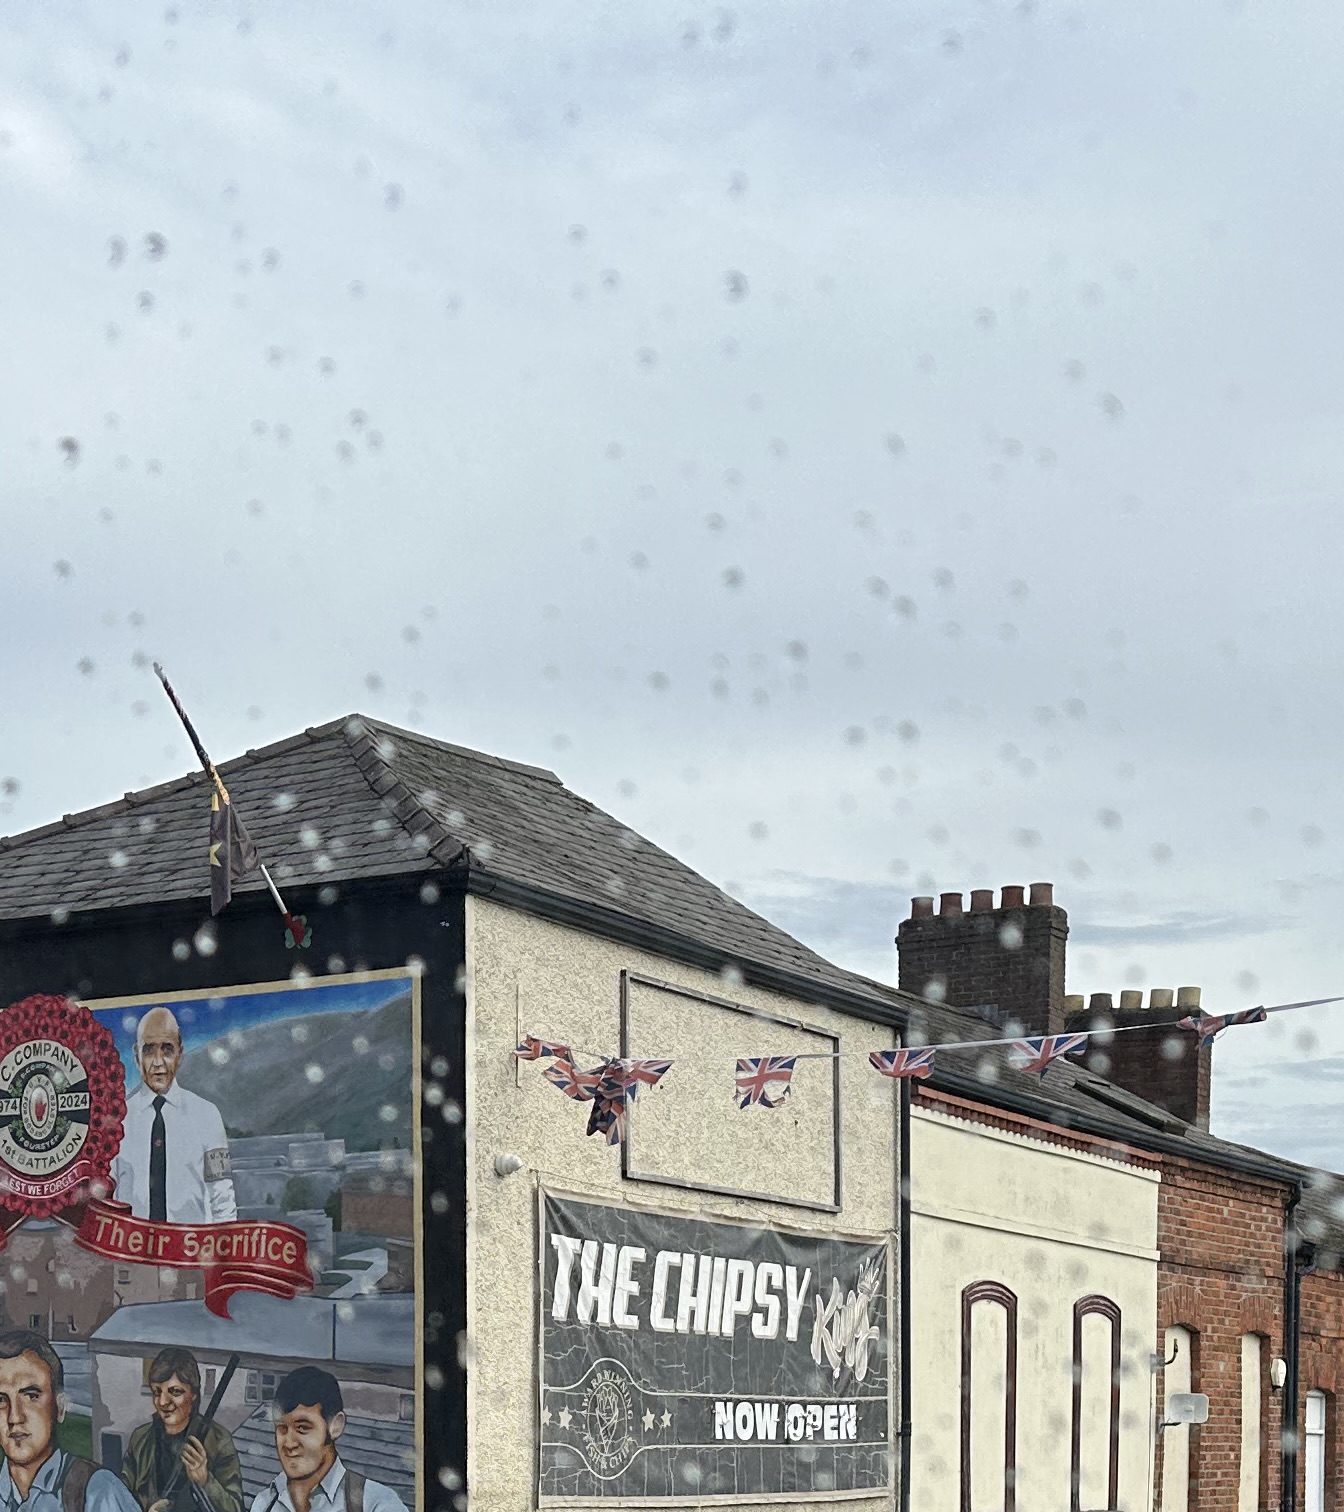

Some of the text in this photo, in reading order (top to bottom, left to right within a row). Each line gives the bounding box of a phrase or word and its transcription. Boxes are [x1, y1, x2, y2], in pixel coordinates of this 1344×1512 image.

[59, 1094, 88, 1109] 2024
[17, 1132, 82, 1169] BATTALION
[27, 1185, 43, 1196] WE
[44, 1169, 79, 1195] FORGET
[95, 1216, 297, 1265] Their Sacrifice
[550, 1233, 811, 1341] THE CHIPSY
[714, 1401, 857, 1442] NOW OPEN
